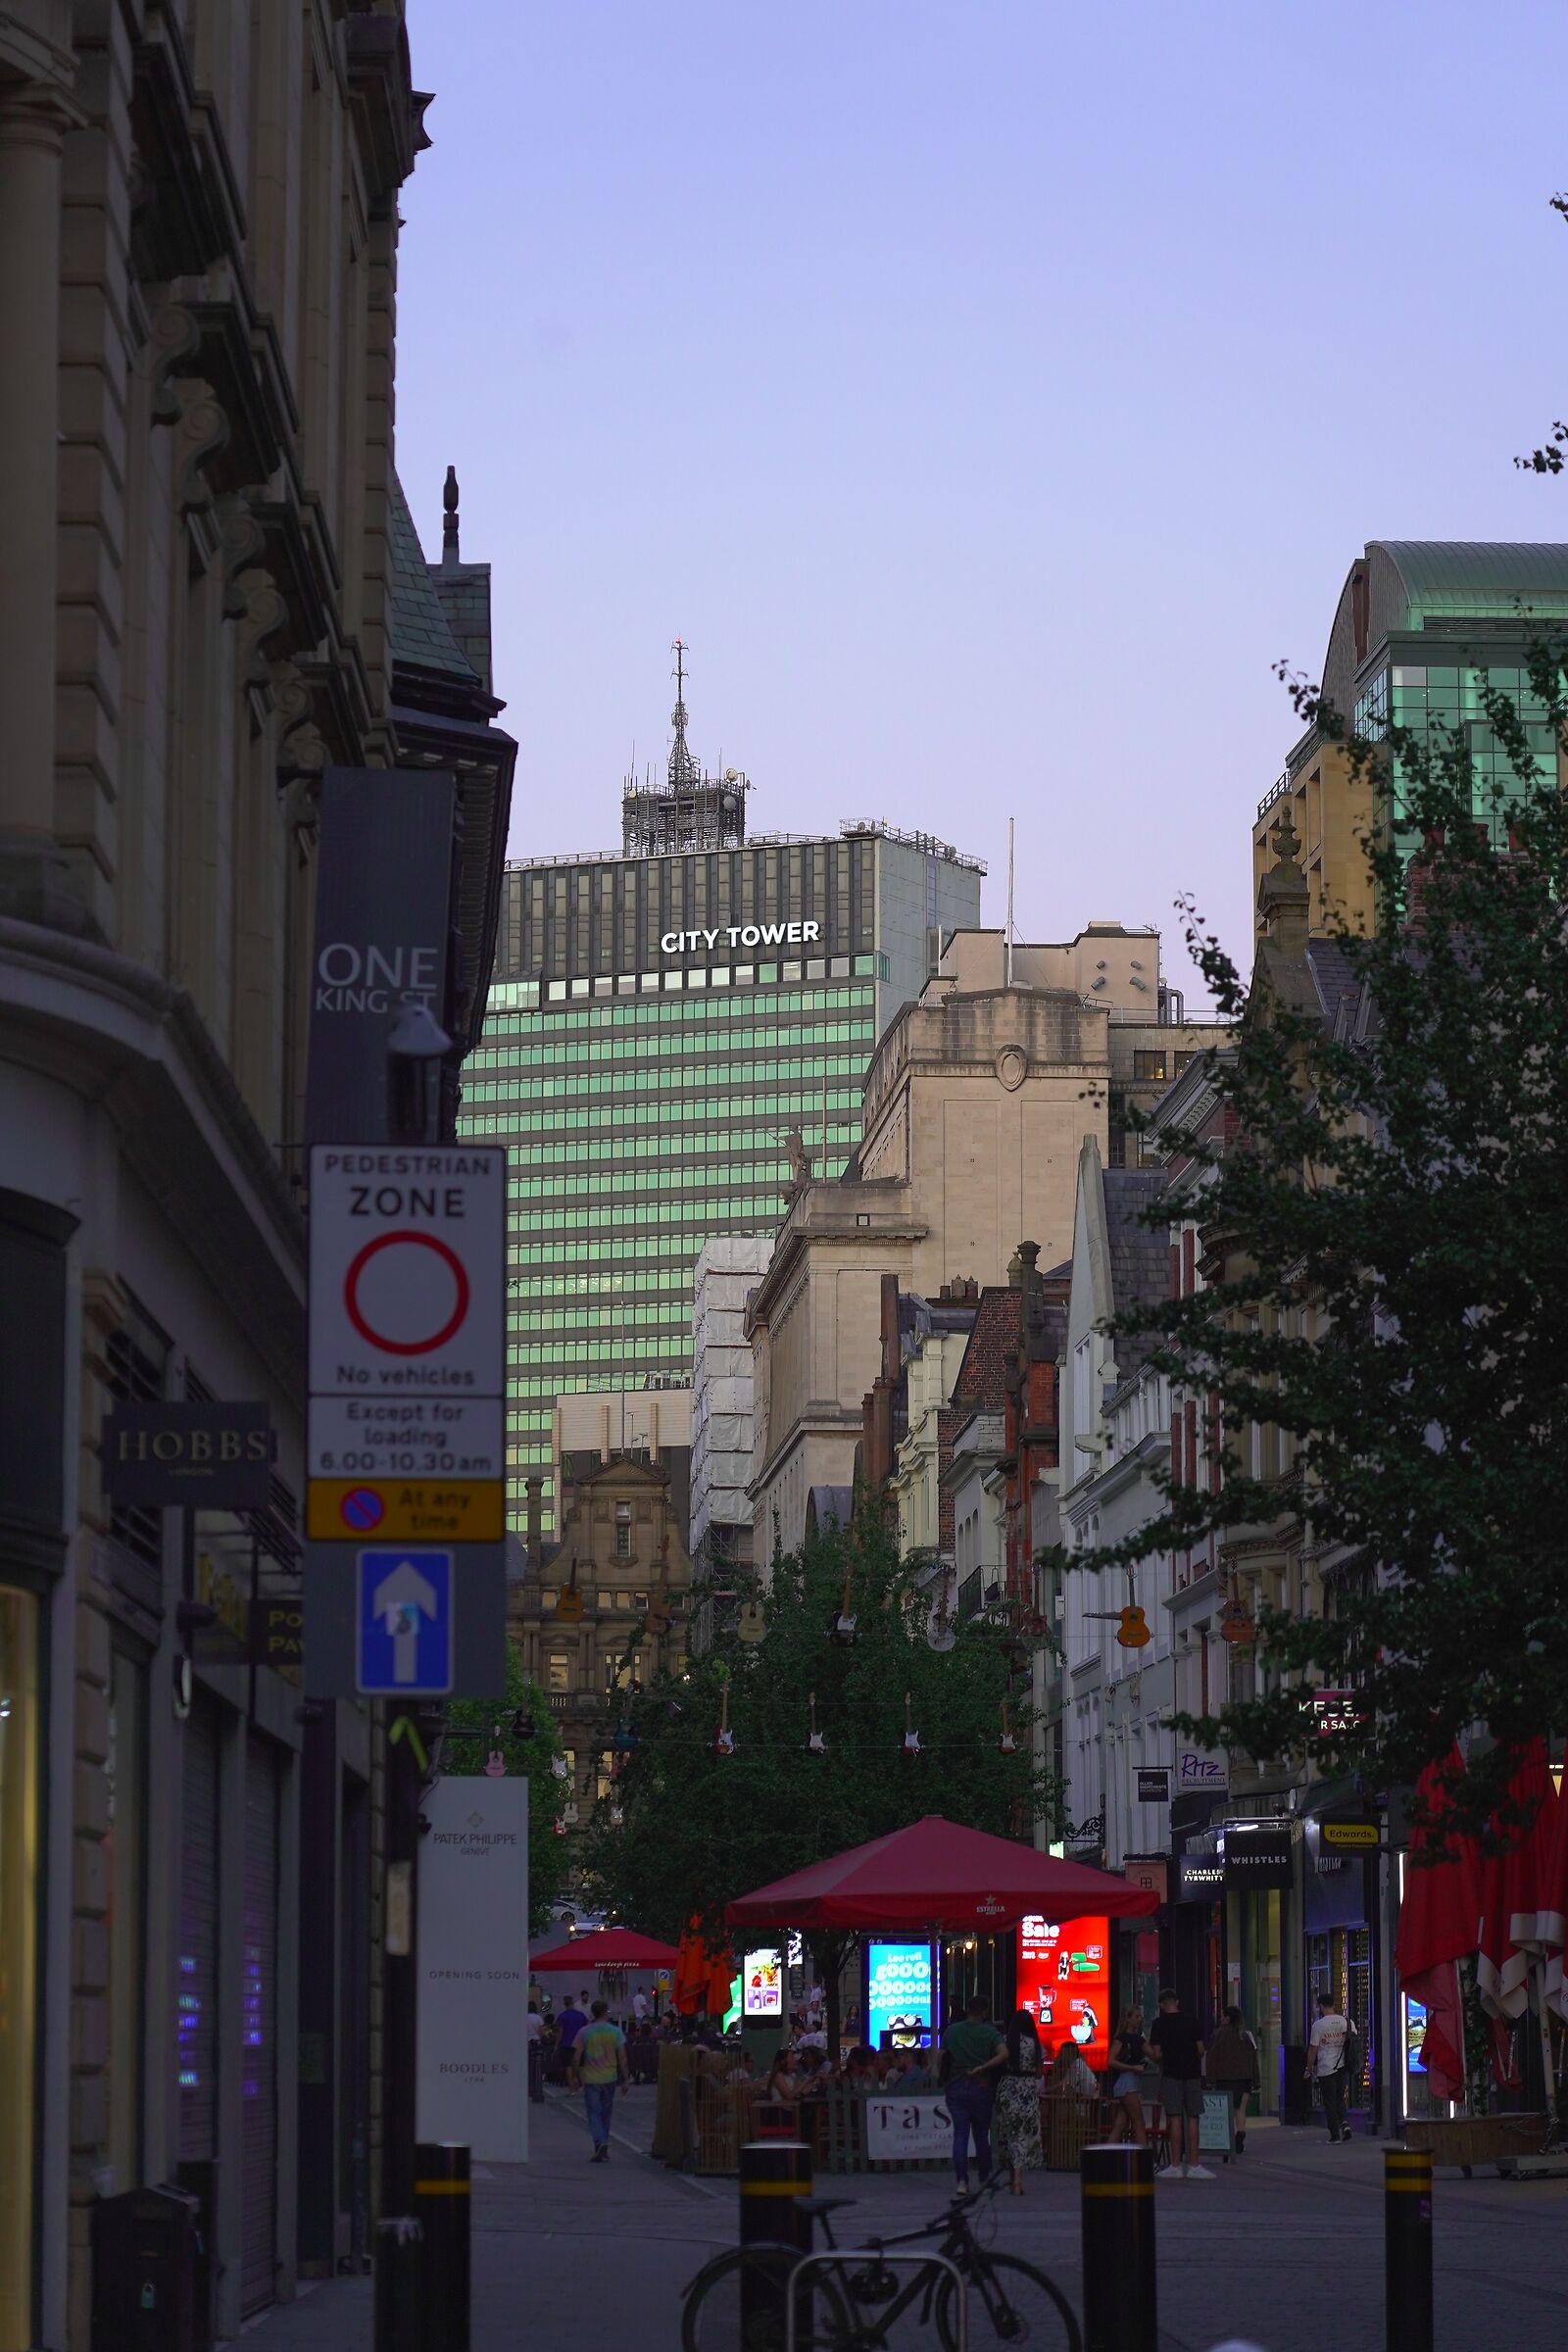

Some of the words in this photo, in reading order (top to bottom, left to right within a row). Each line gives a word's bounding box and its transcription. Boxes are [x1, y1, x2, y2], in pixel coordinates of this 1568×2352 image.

[661, 929, 719, 954] CITY
[726, 920, 819, 948] TOWER
[318, 943, 438, 990] ONE
[316, 988, 388, 1014] KING
[324, 1153, 490, 1176] PEDESTRIAN
[349, 1186, 466, 1217] ZONE
[336, 1366, 370, 1384] No
[379, 1366, 475, 1385] vehicles
[346, 1402, 423, 1424] Except
[432, 1403, 465, 1421] for
[118, 1430, 269, 1461] HOBBS
[365, 1427, 447, 1449] loading
[400, 1488, 424, 1506] At
[432, 1492, 470, 1510] any
[411, 1514, 460, 1530] time
[269, 1610, 303, 1628] PO
[433, 1834, 467, 1844] PATEK
[469, 1834, 517, 1844] PHILIPPE
[1231, 1855, 1287, 1864] WHISTLES
[1021, 1921, 1060, 1937] Sale
[887, 1953, 905, 1962] Loo
[906, 1951, 922, 1961] roll
[429, 1971, 482, 1980] OPENING
[487, 1971, 519, 1980] SOON
[439, 2063, 510, 2074] BOODLES
[873, 2104, 952, 2130] Tas
